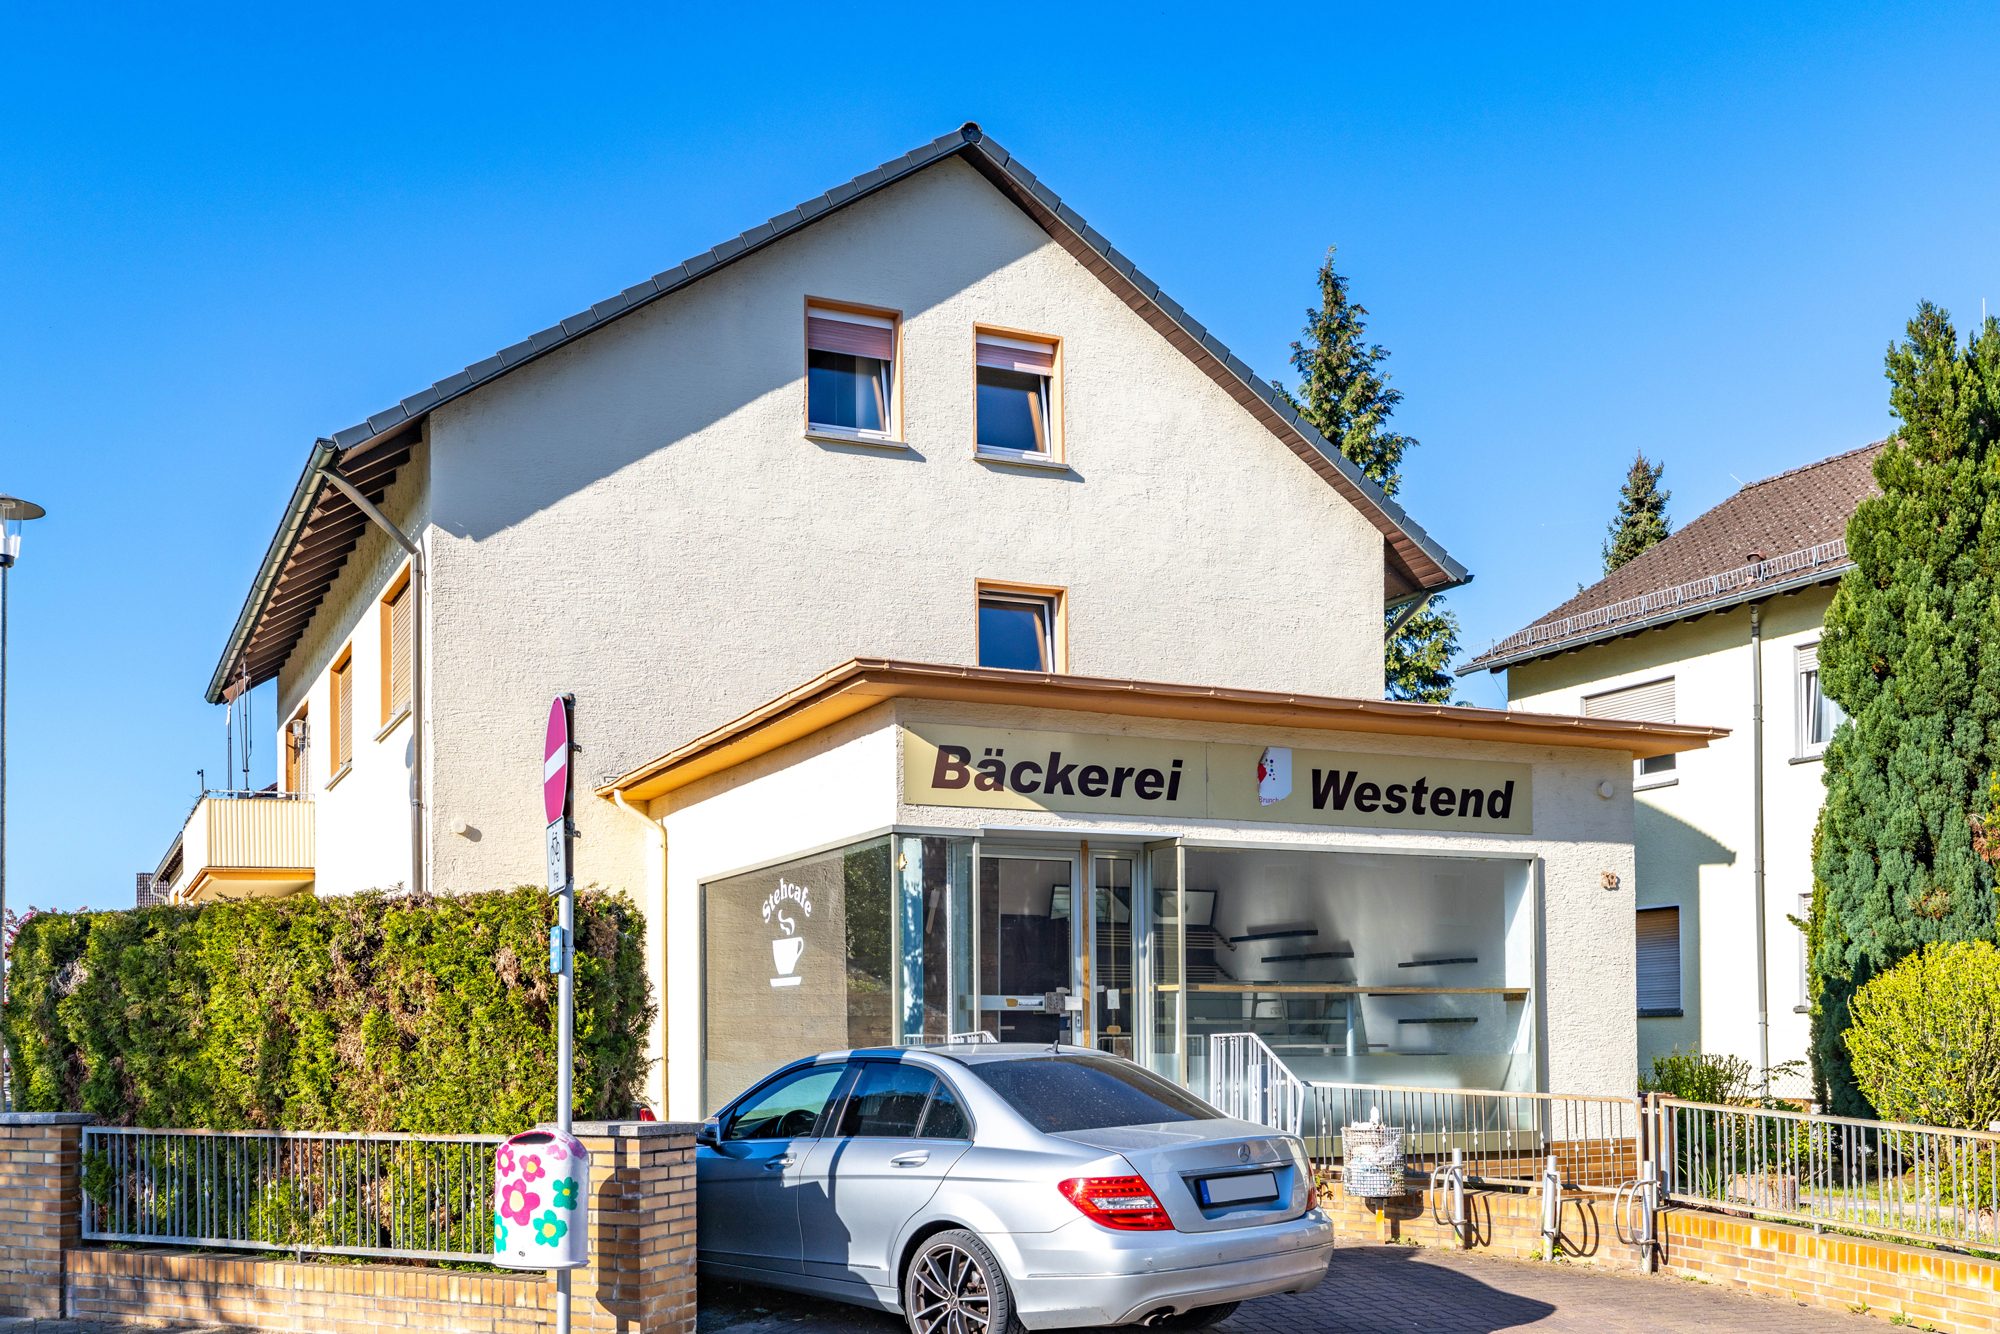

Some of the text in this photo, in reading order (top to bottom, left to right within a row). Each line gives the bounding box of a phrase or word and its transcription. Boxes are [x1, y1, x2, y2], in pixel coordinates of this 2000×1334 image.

[931, 744, 1515, 819] Bäckerei Westend
[762, 877, 812, 924] Stehcafe
